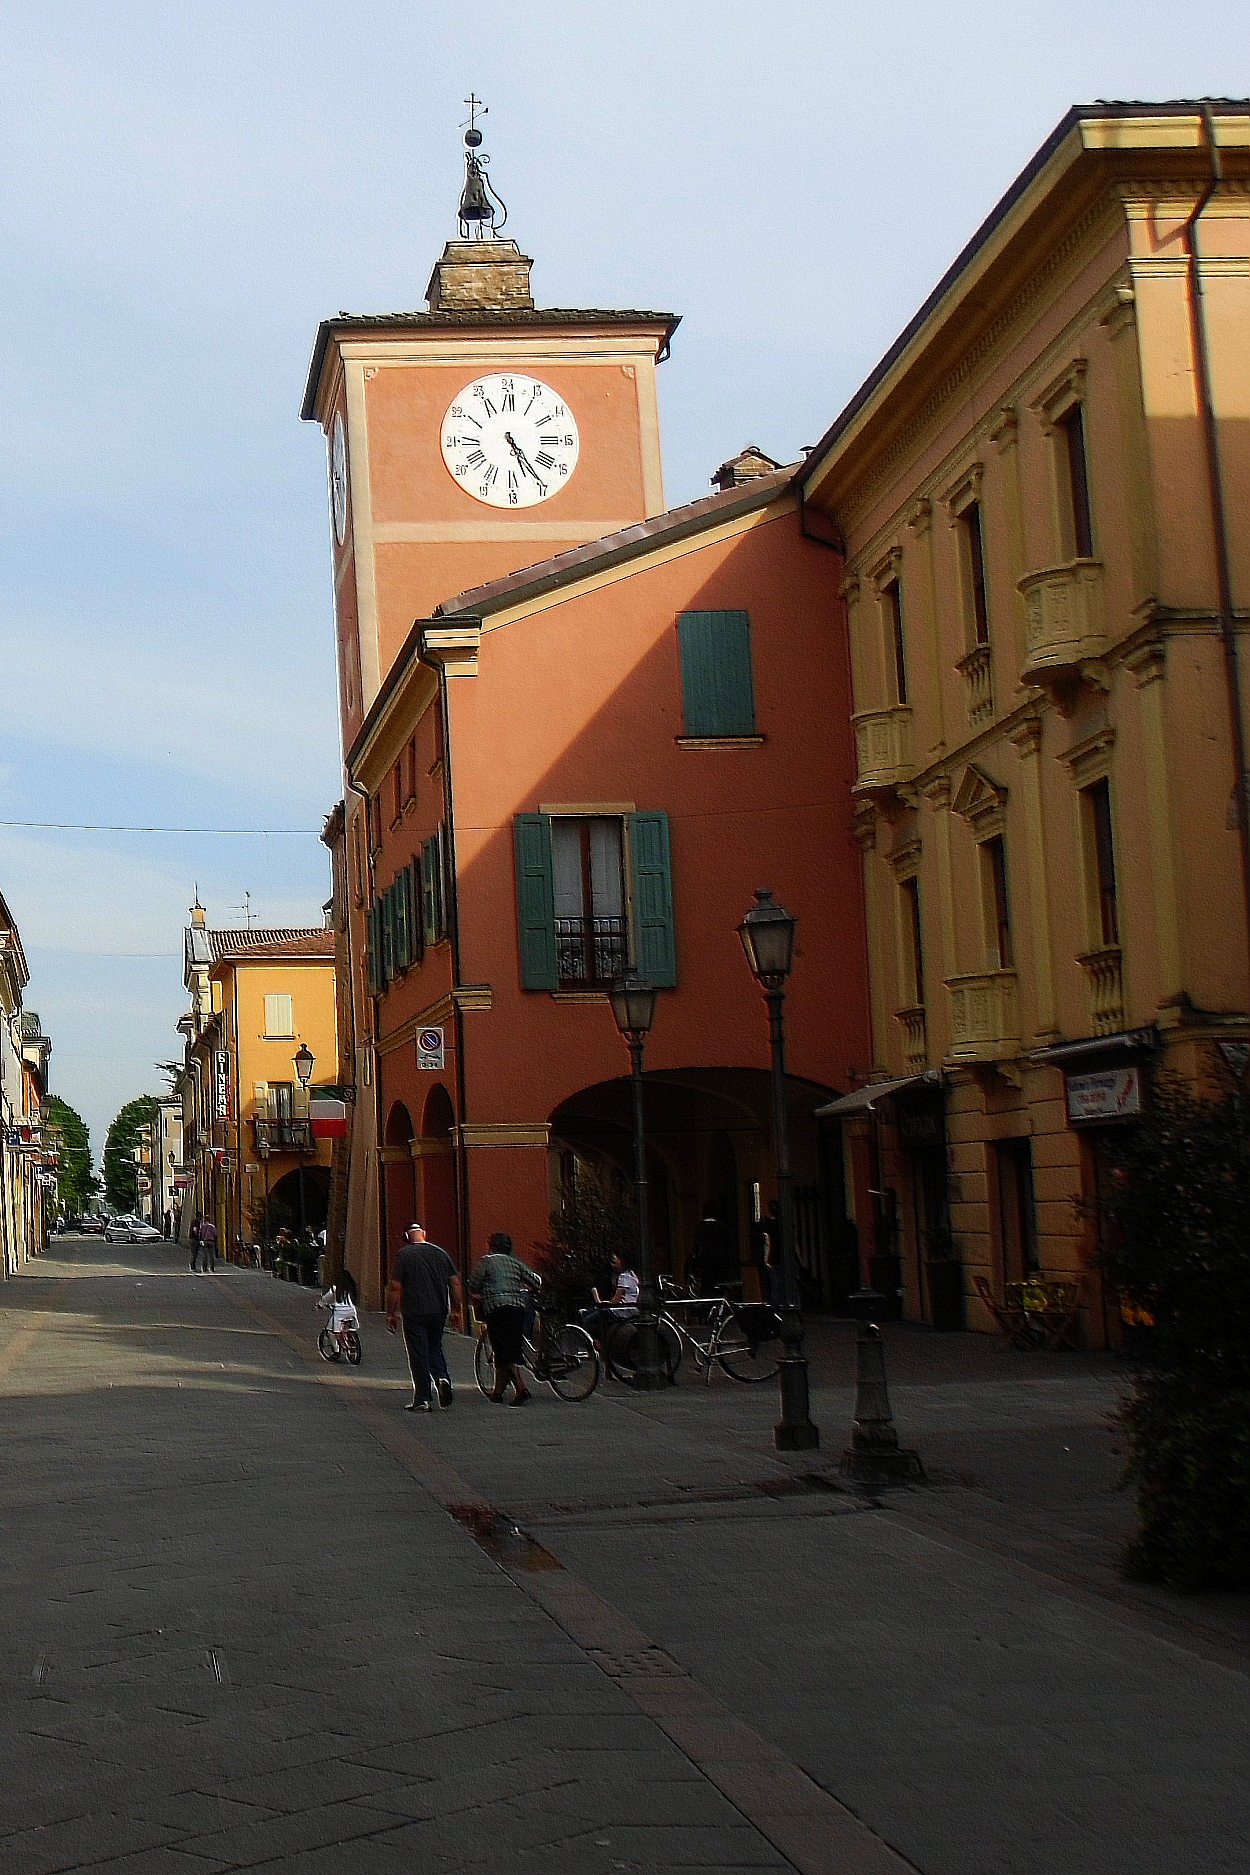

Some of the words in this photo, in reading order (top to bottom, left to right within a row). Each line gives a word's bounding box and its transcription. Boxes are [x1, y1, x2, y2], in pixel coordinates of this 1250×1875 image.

[502, 378, 514, 390] 24
[473, 385, 485, 397] 23
[533, 385, 542, 397] 13
[555, 405, 564, 417] 14
[446, 435, 457, 448] 21
[564, 434, 574, 446] 15
[539, 484, 549, 497] 17
